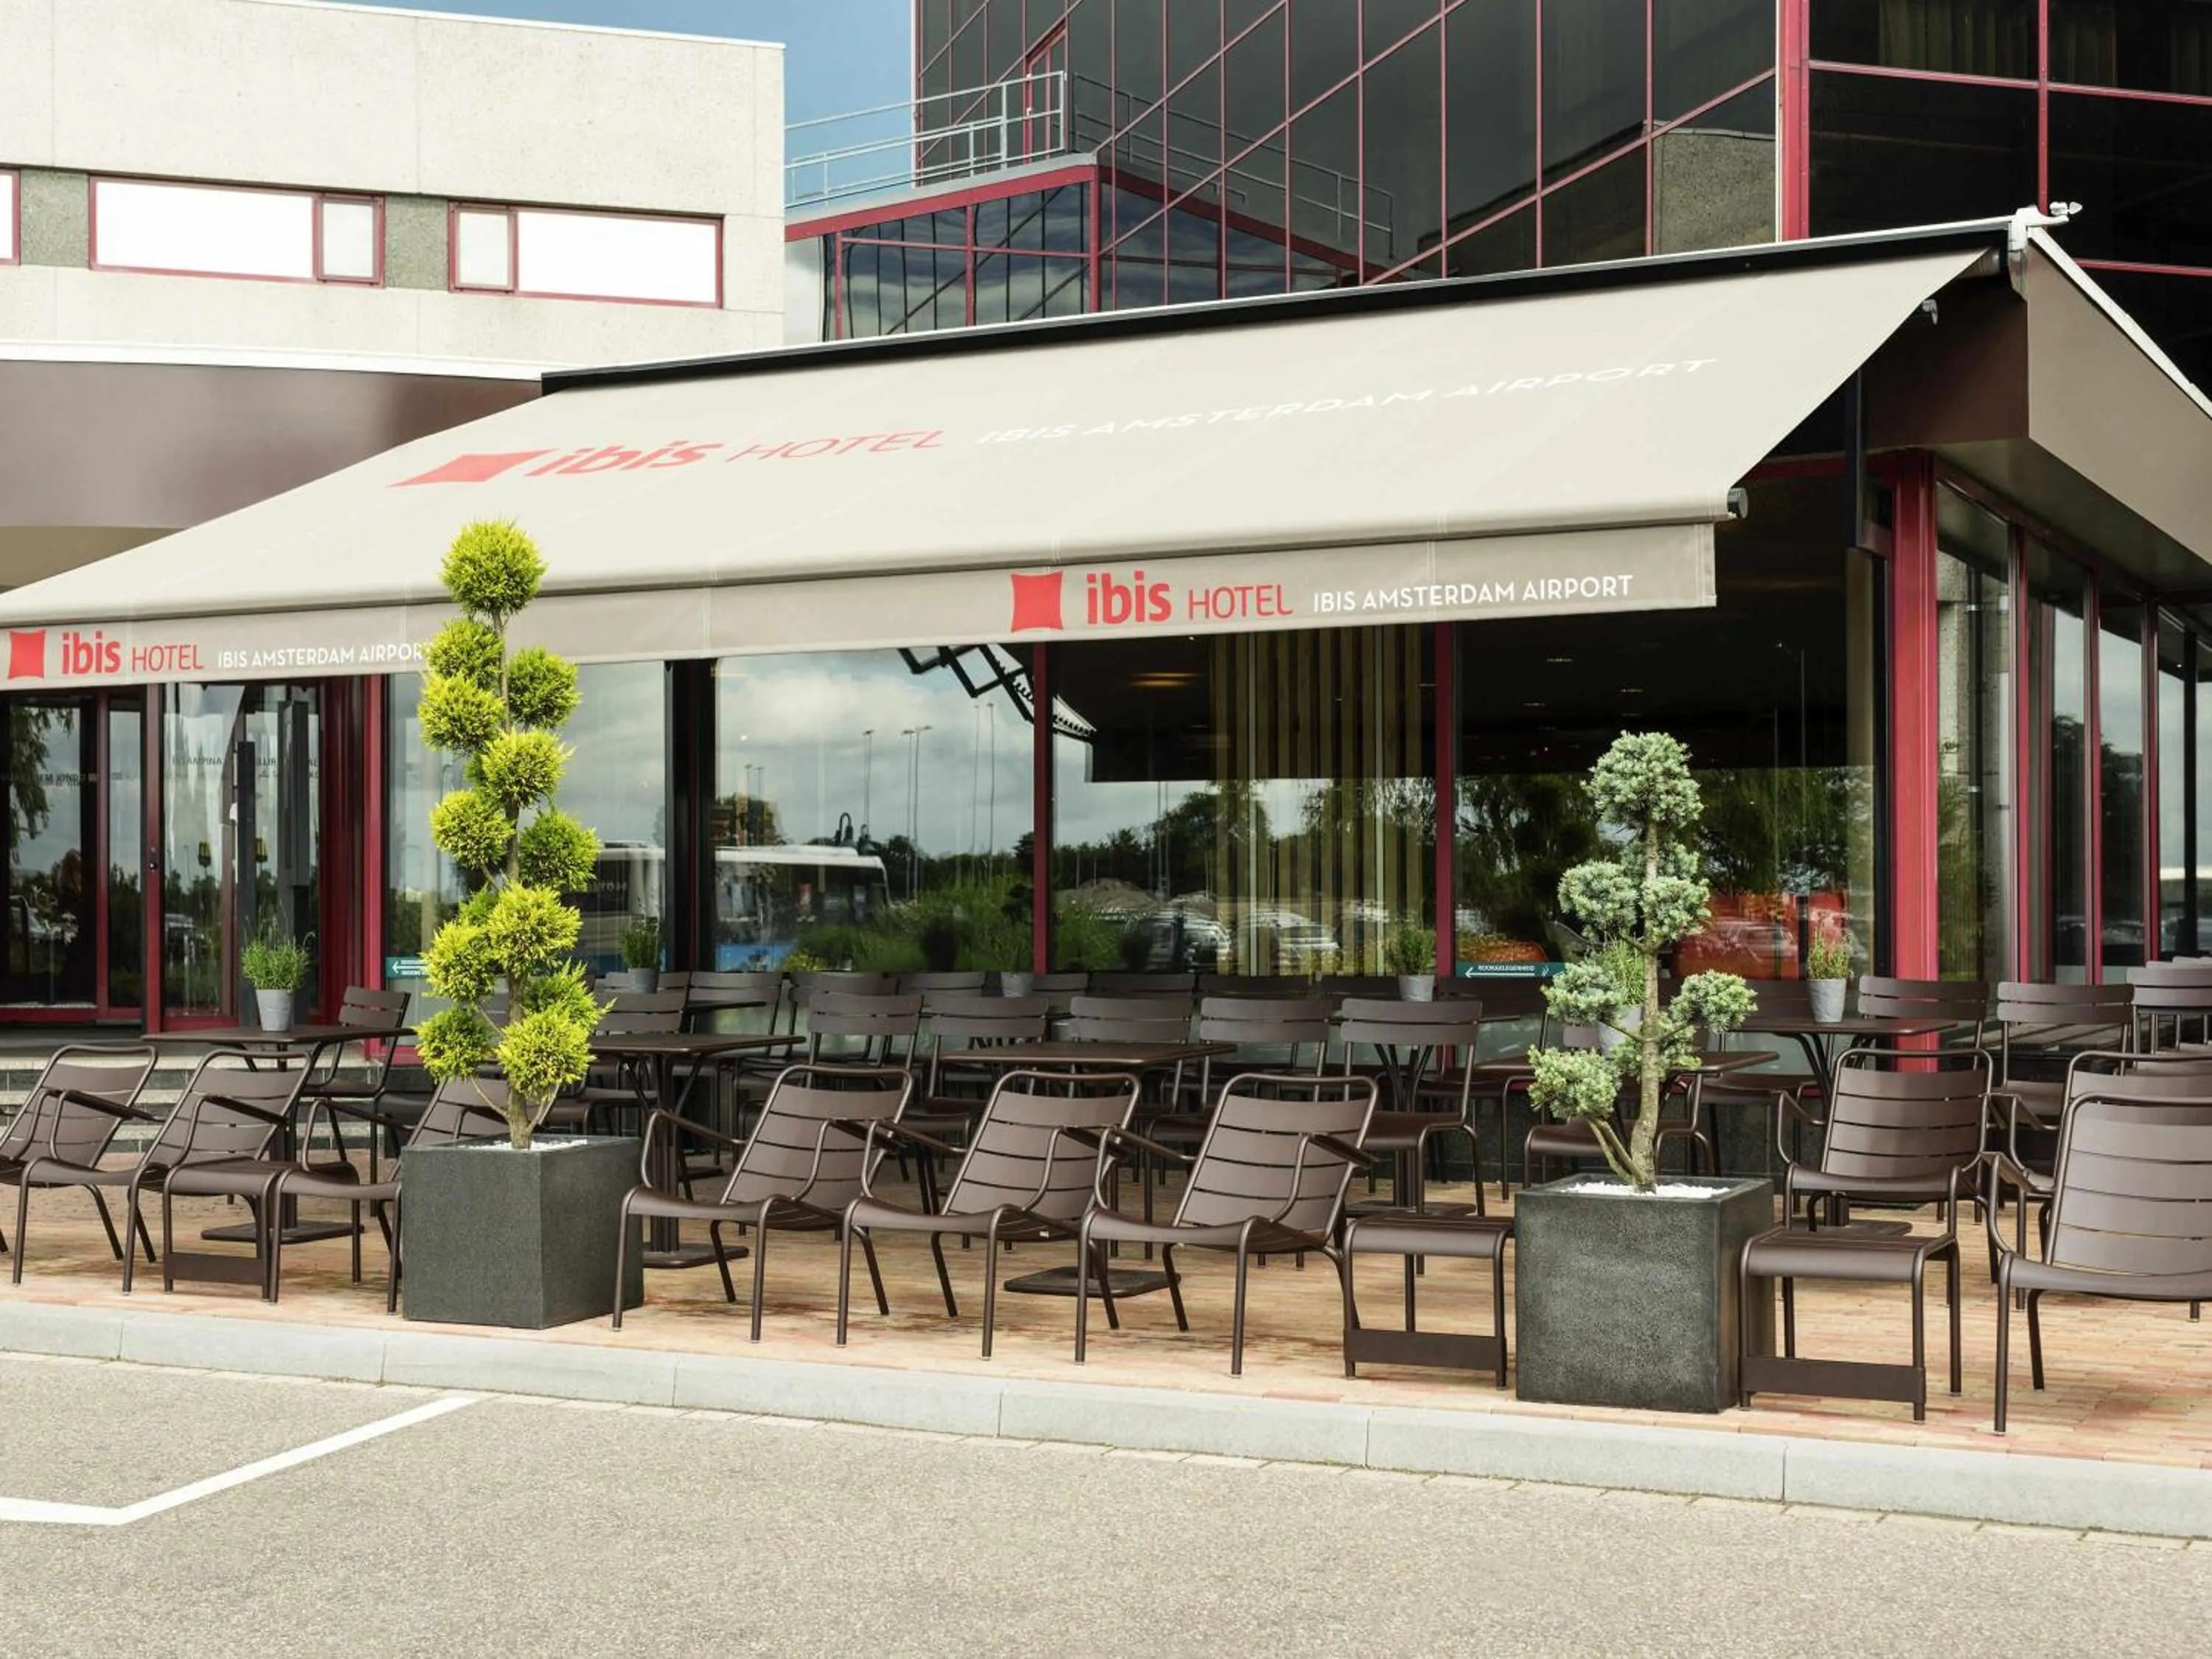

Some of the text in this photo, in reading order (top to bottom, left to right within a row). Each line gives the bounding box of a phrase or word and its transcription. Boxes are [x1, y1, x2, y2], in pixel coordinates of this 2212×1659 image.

[524, 358, 1718, 476] ibis HOTEL IBIS AMSTERDAM AIRPORT
[1086, 569, 1635, 625] ibis HOTEL IBIS AMSTERDAM AIRPORT
[61, 632, 431, 675] ibis HOTEL IBIS AMSTERDAM AIRPOR
